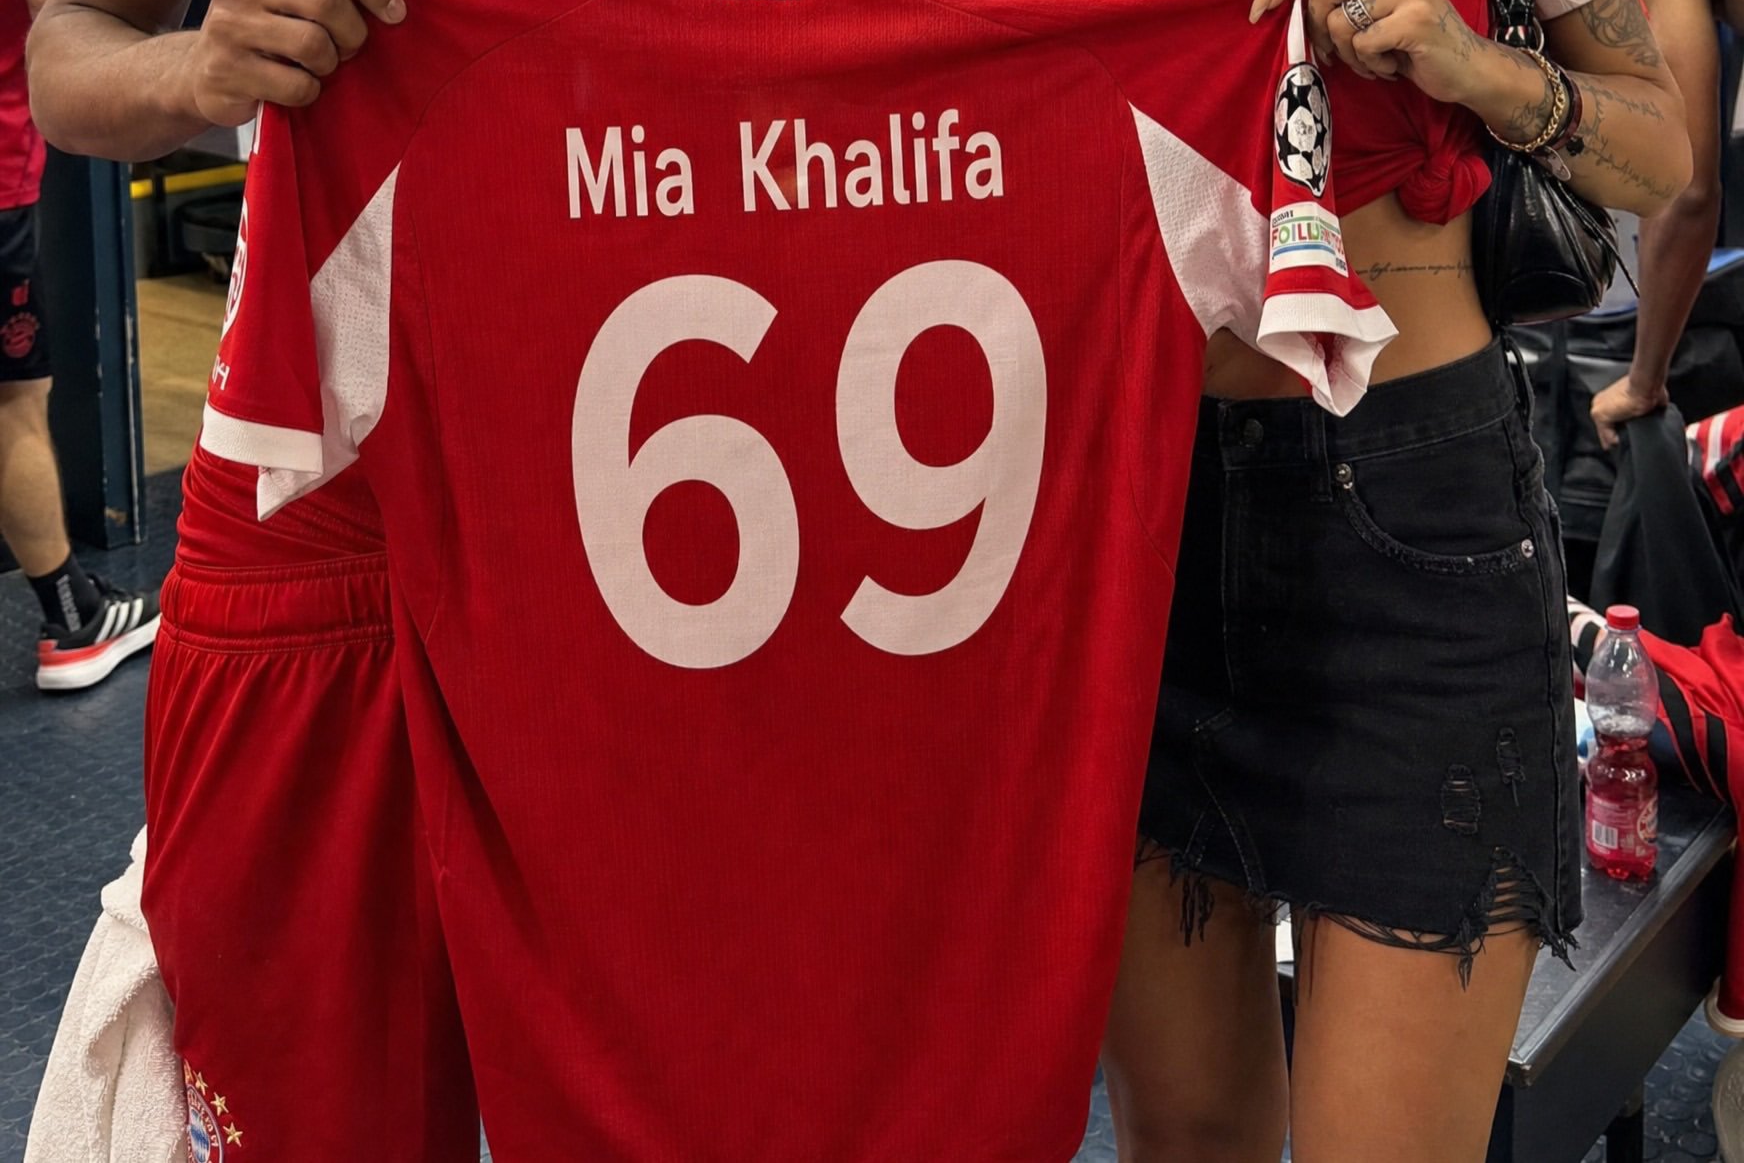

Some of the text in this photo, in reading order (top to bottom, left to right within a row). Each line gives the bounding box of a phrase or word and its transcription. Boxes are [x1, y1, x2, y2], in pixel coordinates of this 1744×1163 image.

[565, 108, 1005, 218] Mia Khalifa
[571, 259, 1048, 669] 69
